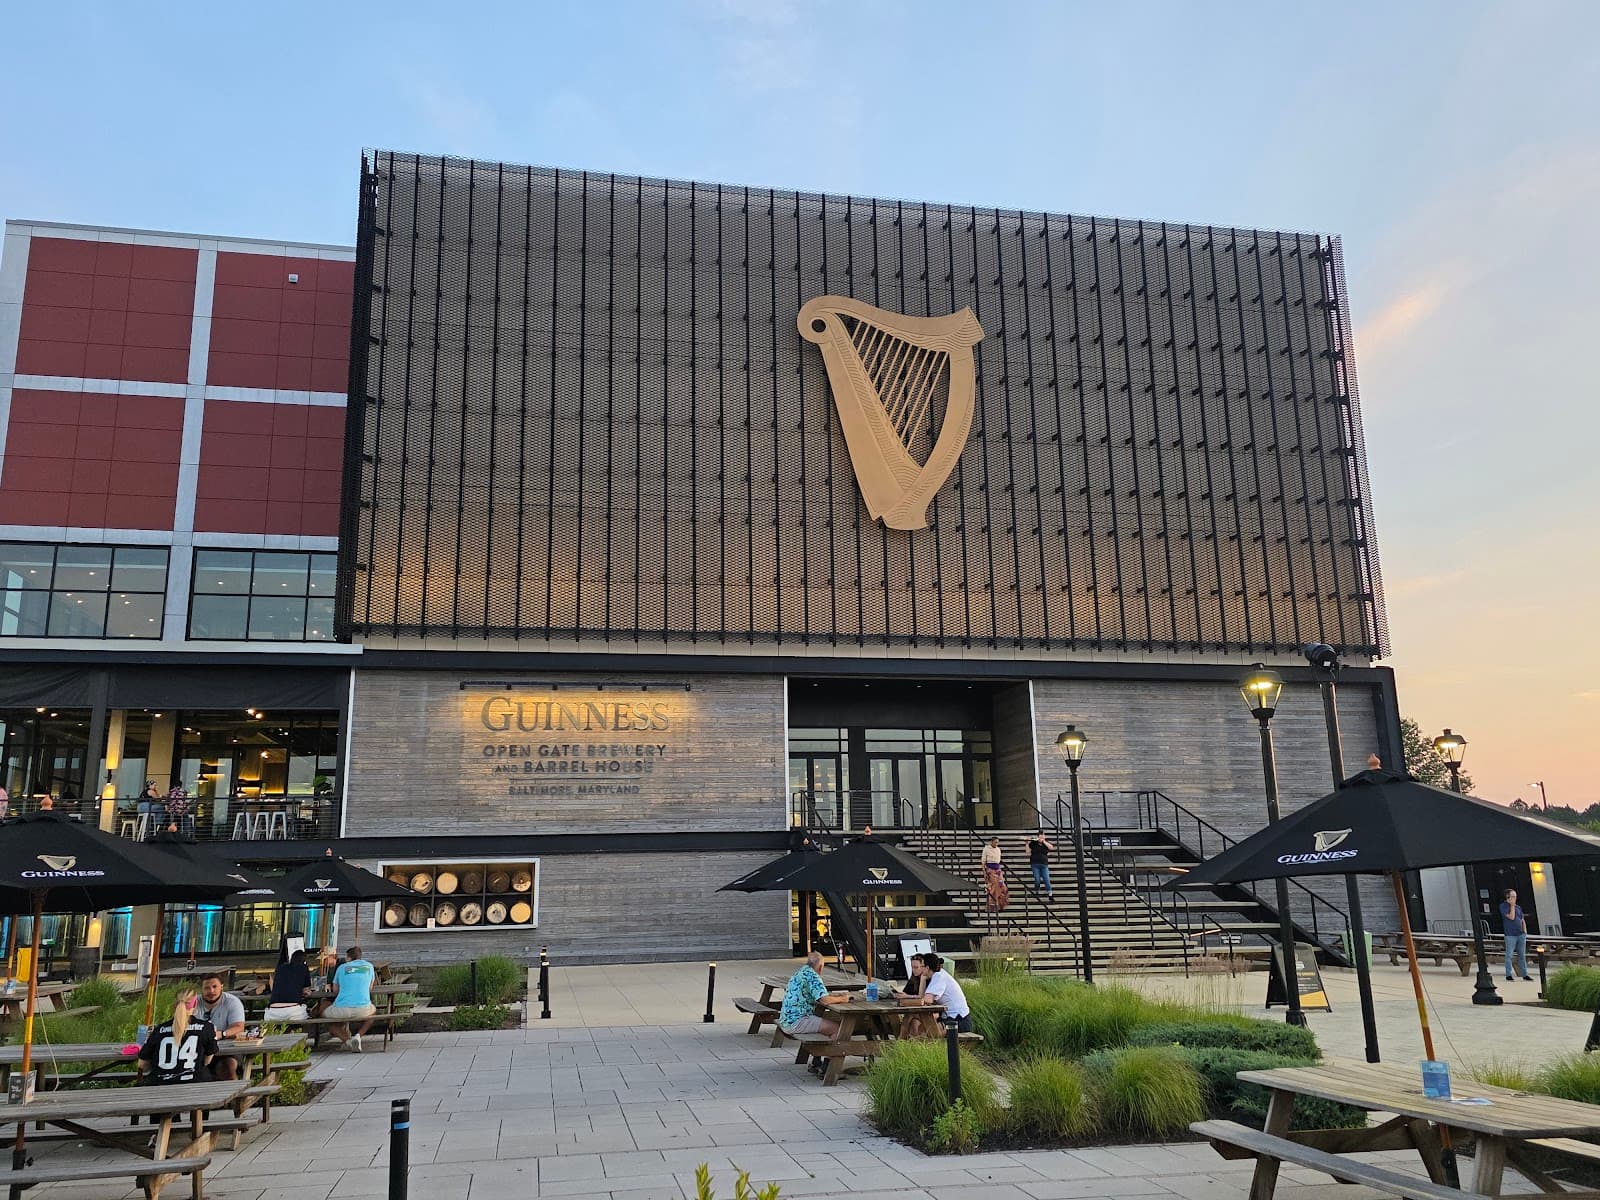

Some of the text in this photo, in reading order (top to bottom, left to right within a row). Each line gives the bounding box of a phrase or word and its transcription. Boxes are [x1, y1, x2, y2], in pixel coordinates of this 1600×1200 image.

[480, 696, 670, 731] GUINNESS
[483, 745, 531, 757] OPEN
[538, 745, 580, 757] GATE
[495, 761, 654, 773] AND BARREL HOUSE
[577, 785, 641, 795] MARYLAND
[1277, 850, 1358, 863] GUINNESS
[21, 870, 105, 878] GUINNESS
[158, 1035, 199, 1070] 04
